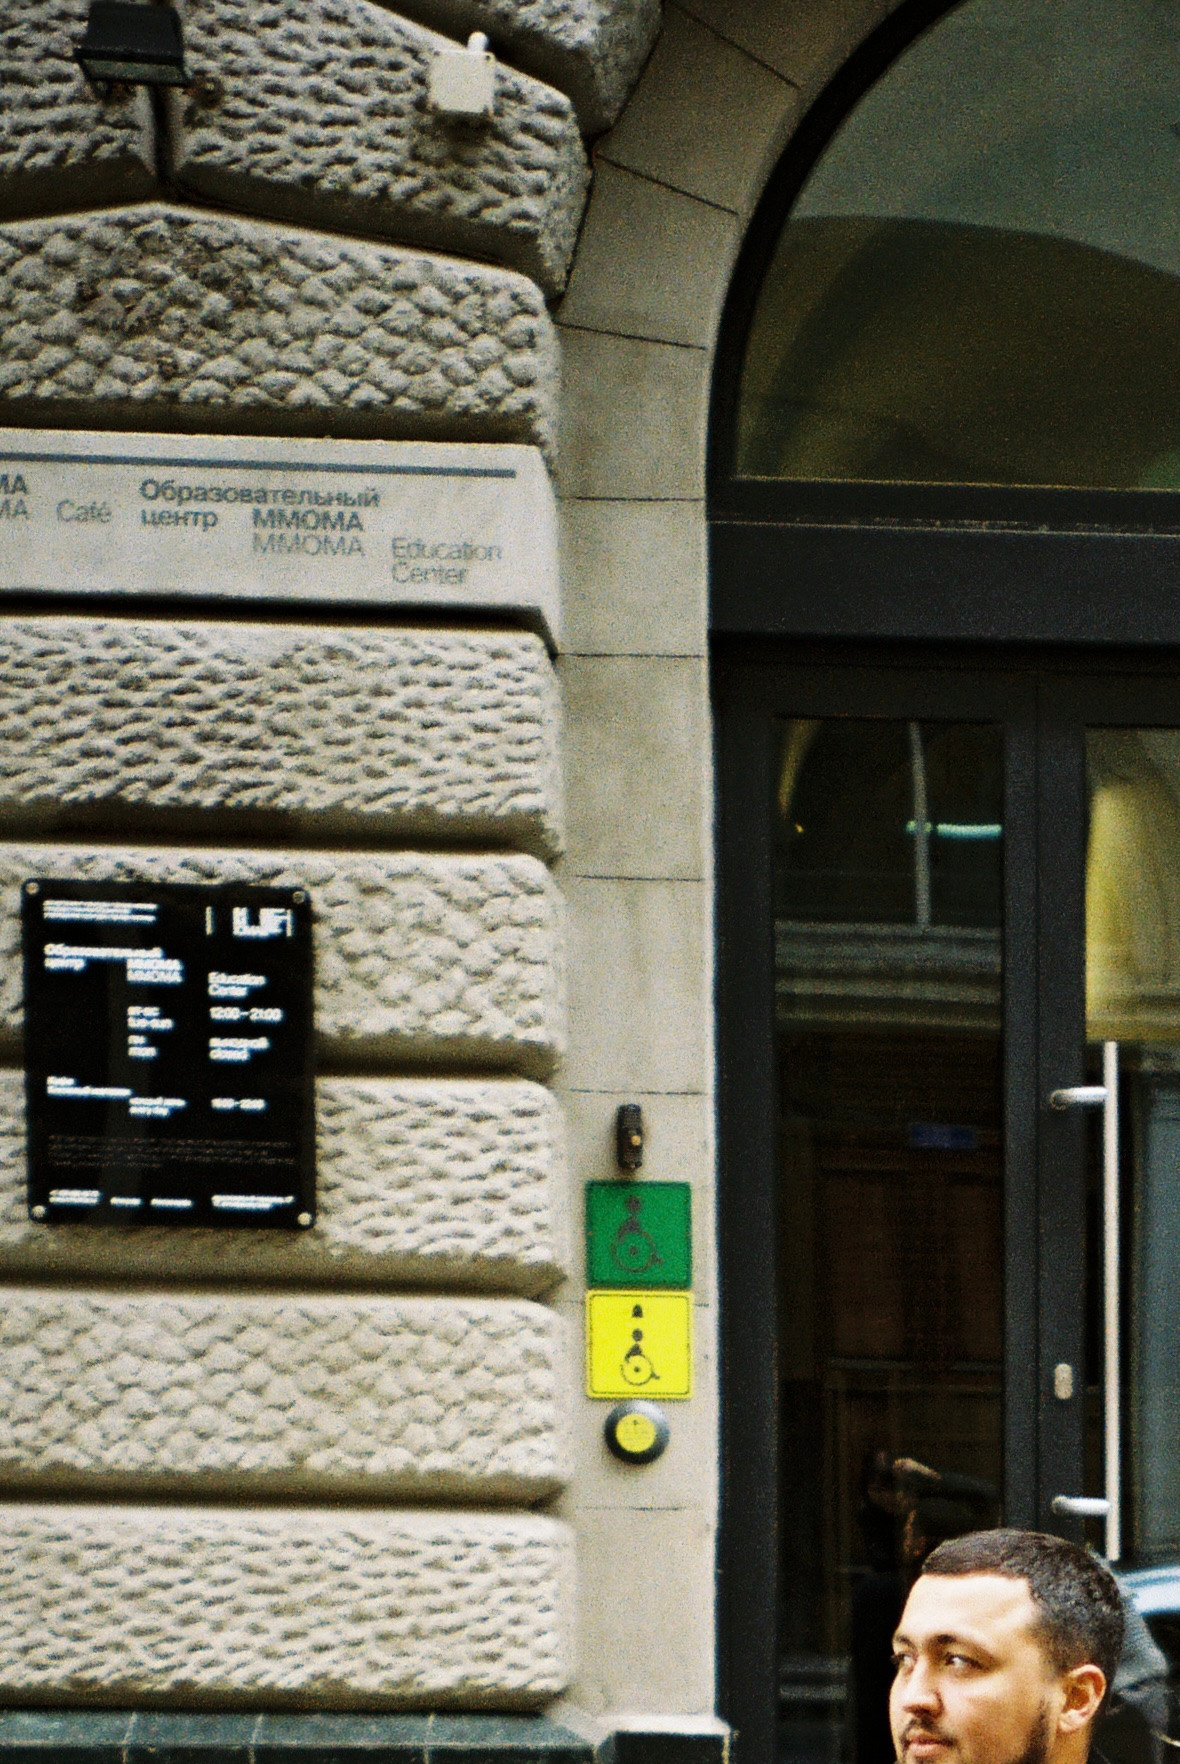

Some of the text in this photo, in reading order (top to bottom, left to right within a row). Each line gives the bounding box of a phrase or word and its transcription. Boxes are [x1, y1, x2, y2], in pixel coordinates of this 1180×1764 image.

[139, 478, 381, 508] Образовательный
[140, 508, 365, 532] центр ММОМА
[252, 532, 503, 561] MMOMA Education
[391, 561, 468, 585] Center
